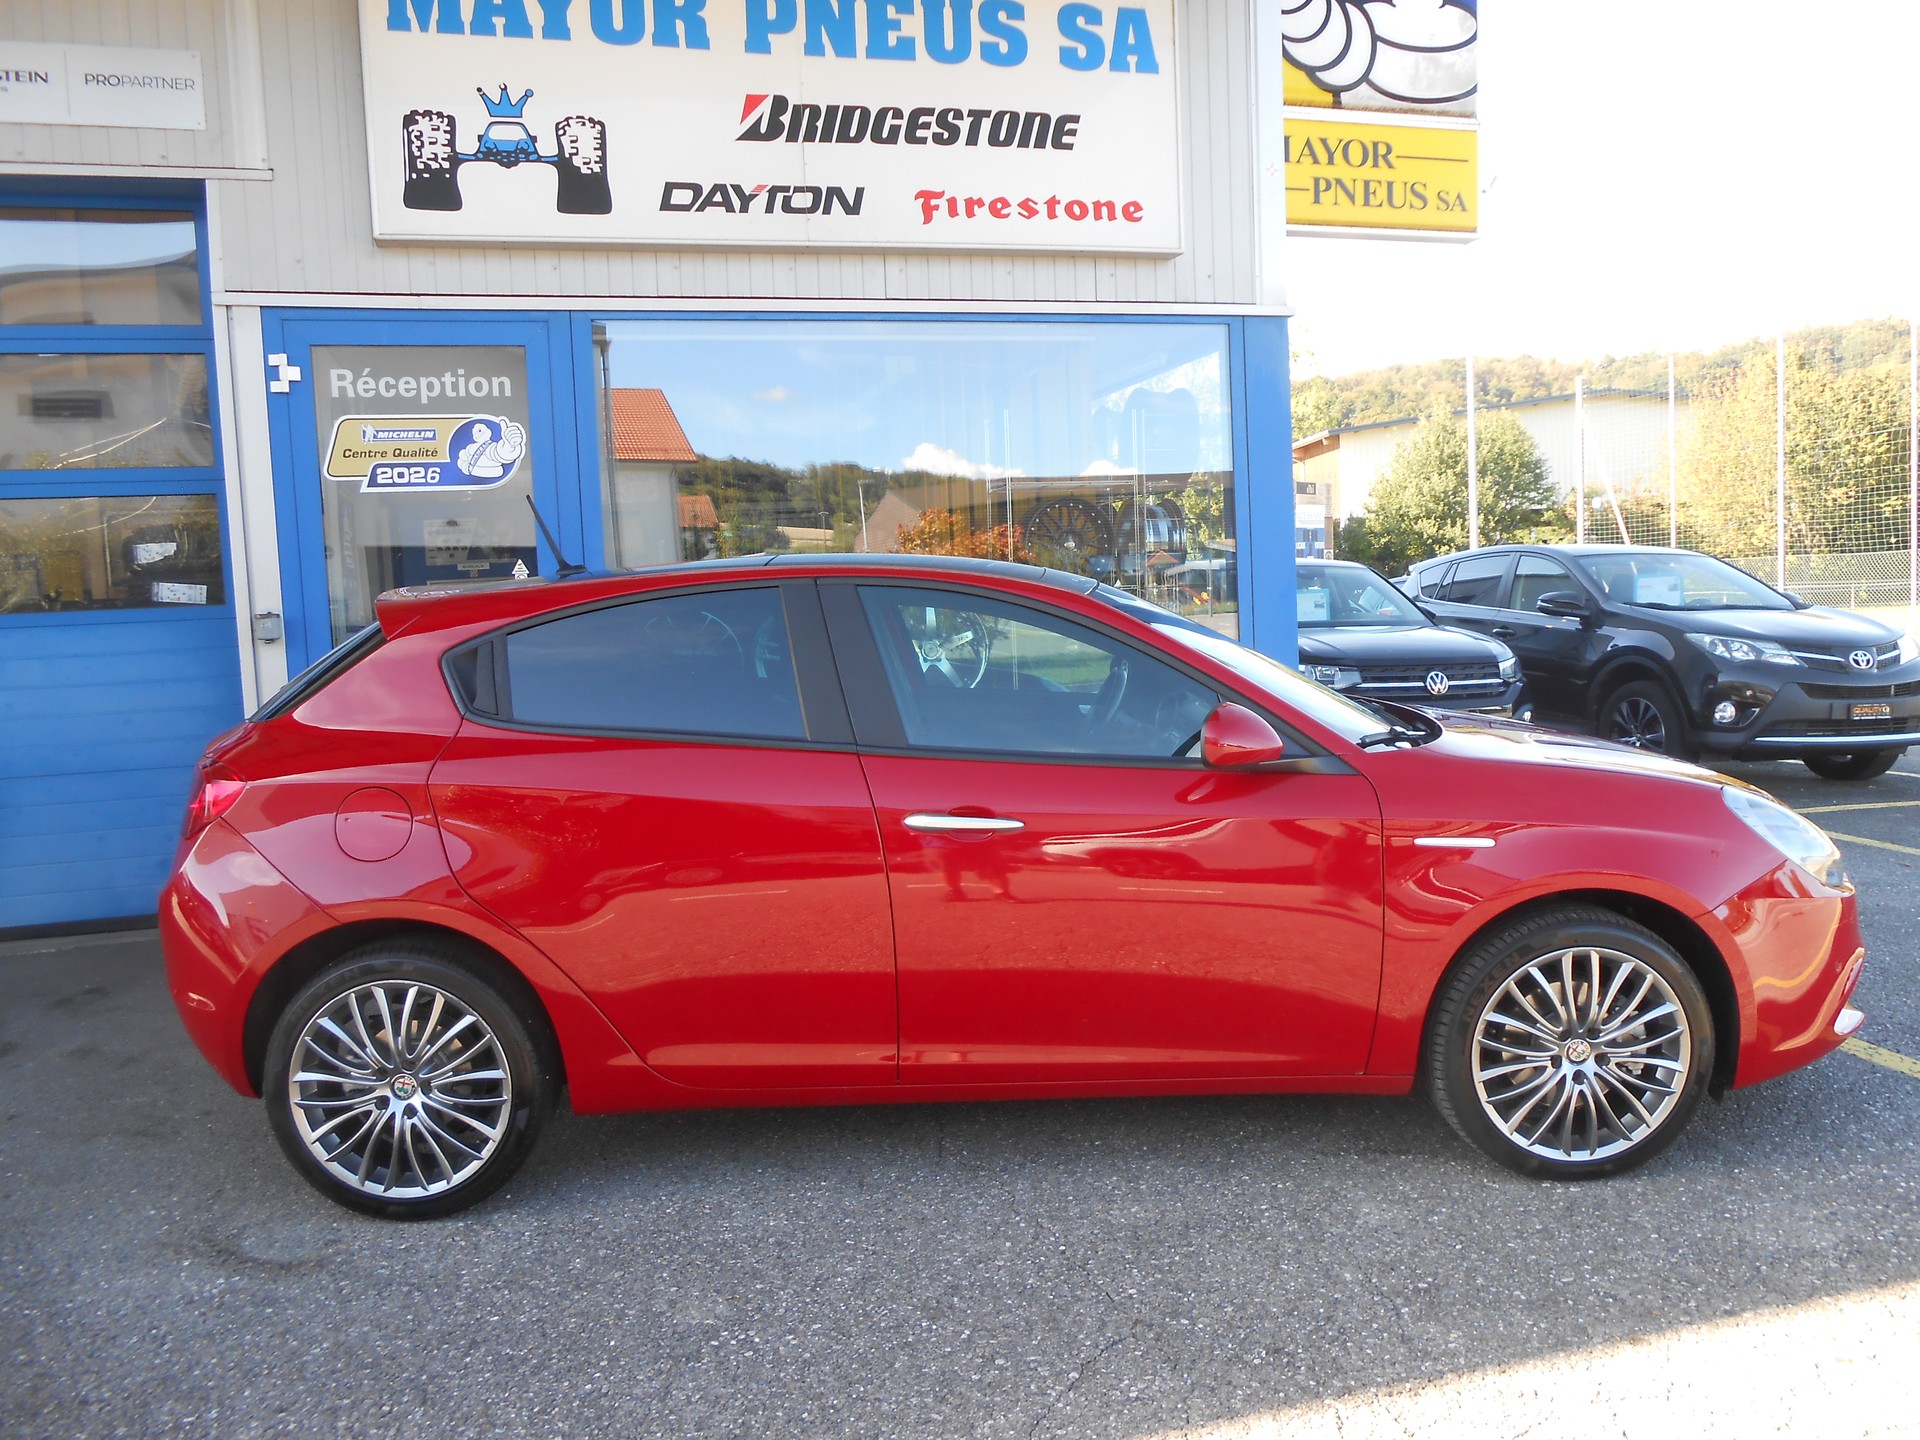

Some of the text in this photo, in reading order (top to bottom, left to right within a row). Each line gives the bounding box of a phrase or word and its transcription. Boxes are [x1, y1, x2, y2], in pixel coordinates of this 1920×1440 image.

[744, 0, 1028, 67] PNEUS
[1057, 2, 1159, 74] SA
[84, 73, 195, 91] PROPARTNER
[735, 94, 1081, 151] BRIDGESTONE
[659, 181, 865, 216] DAYTON
[914, 189, 1144, 225] Firestone
[1311, 176, 1468, 212] PNEUS SA
[329, 368, 512, 403] Réception
[376, 429, 435, 440] MICHELIN
[342, 447, 439, 459] Centre Qualité
[376, 467, 441, 484] 2026
